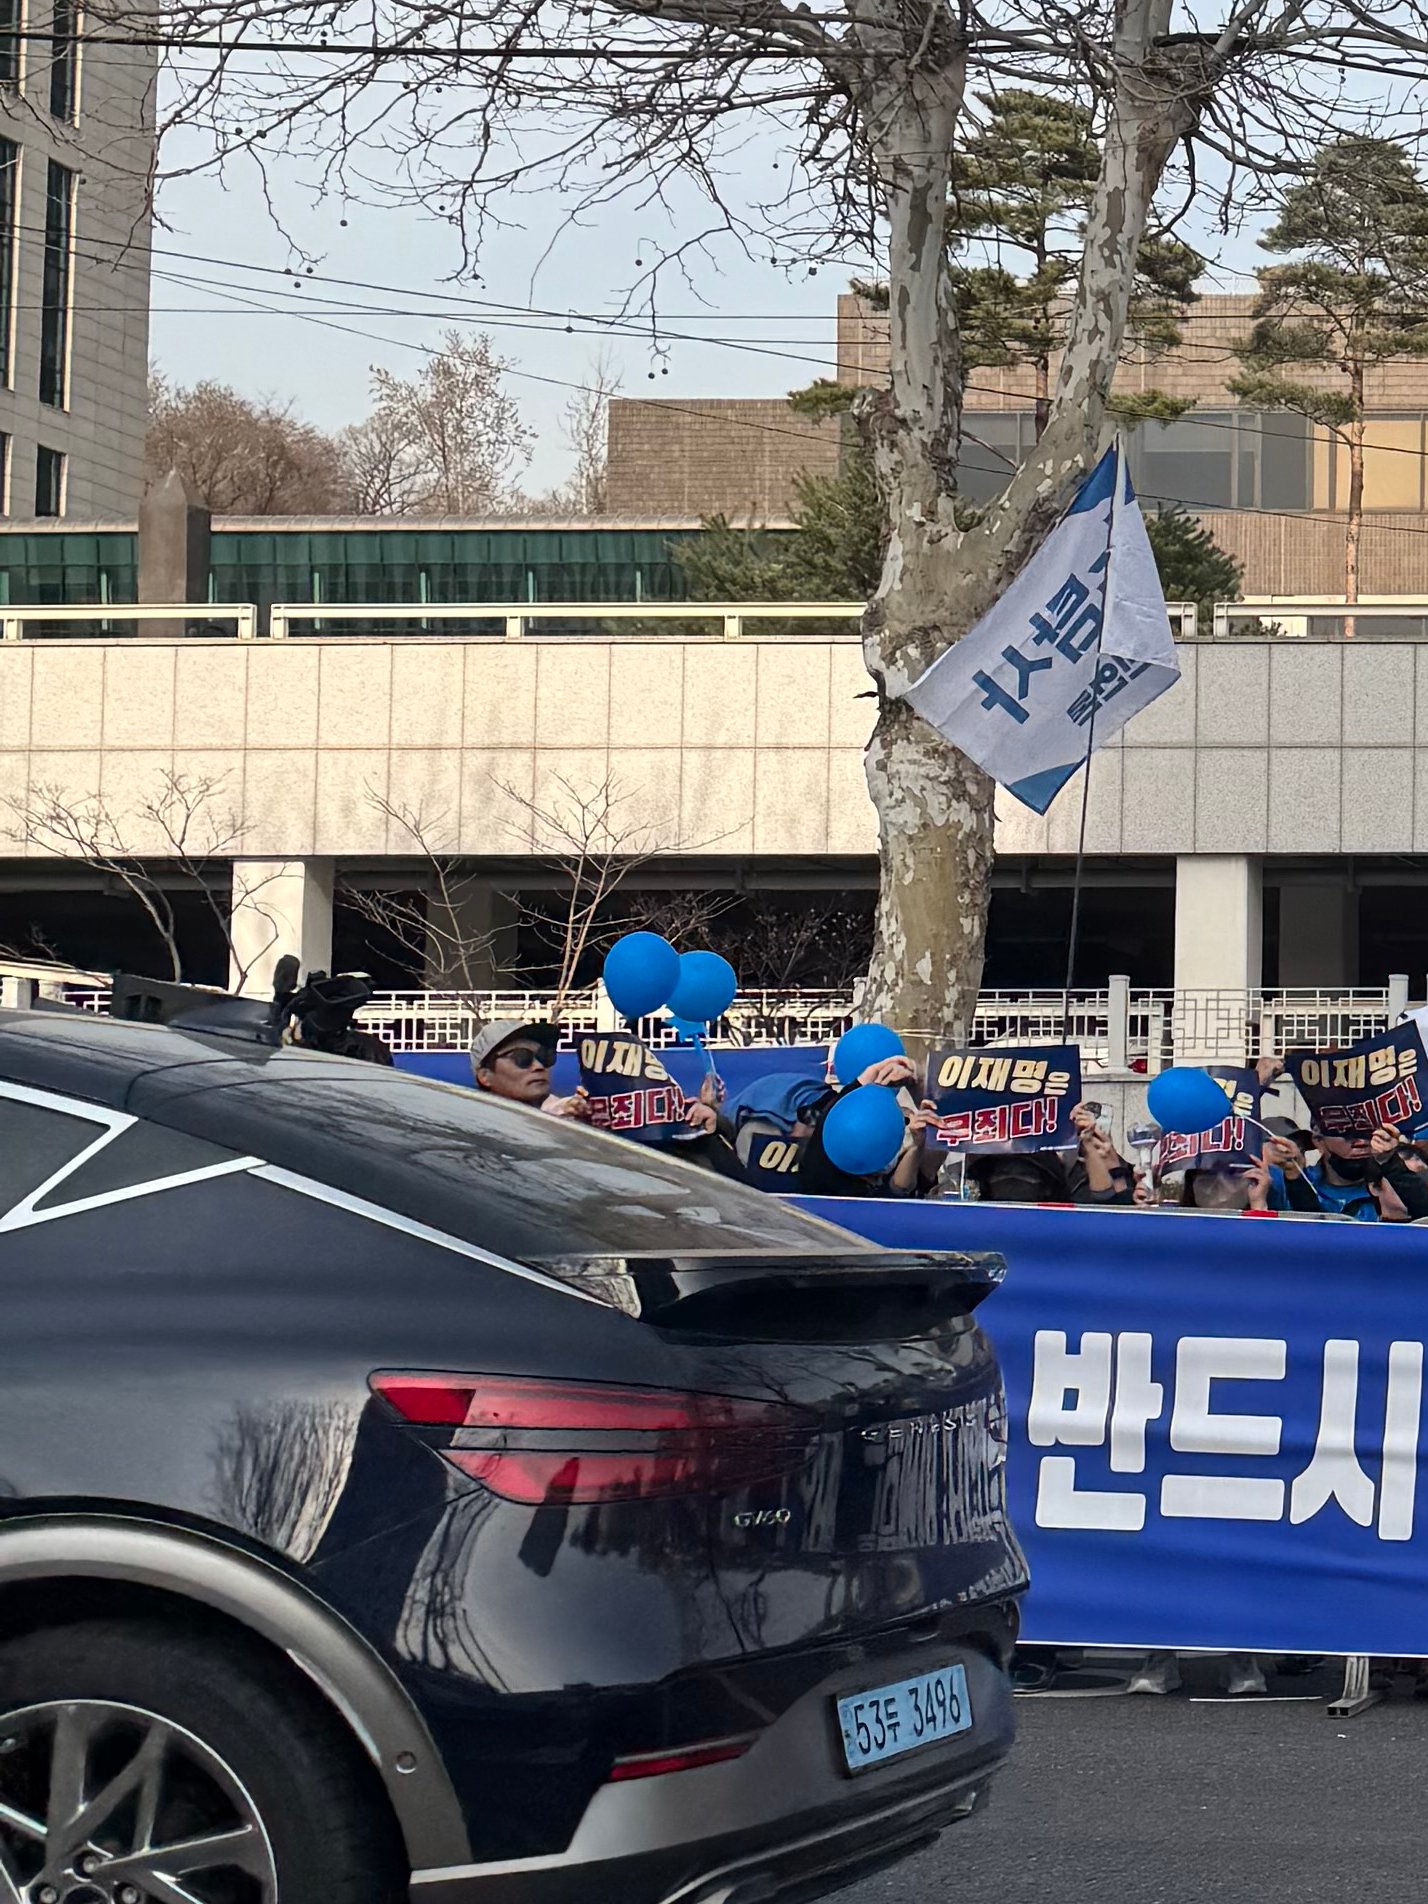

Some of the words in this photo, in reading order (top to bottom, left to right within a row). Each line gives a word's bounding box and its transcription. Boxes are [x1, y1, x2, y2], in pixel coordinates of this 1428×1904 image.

[937, 1054, 1072, 1096] 이재명은
[935, 1096, 1059, 1146] 무죄다!
[1027, 1329, 1424, 1542] 반드시
[733, 1507, 792, 1529] GV60
[908, 1673, 962, 1738] 3496
